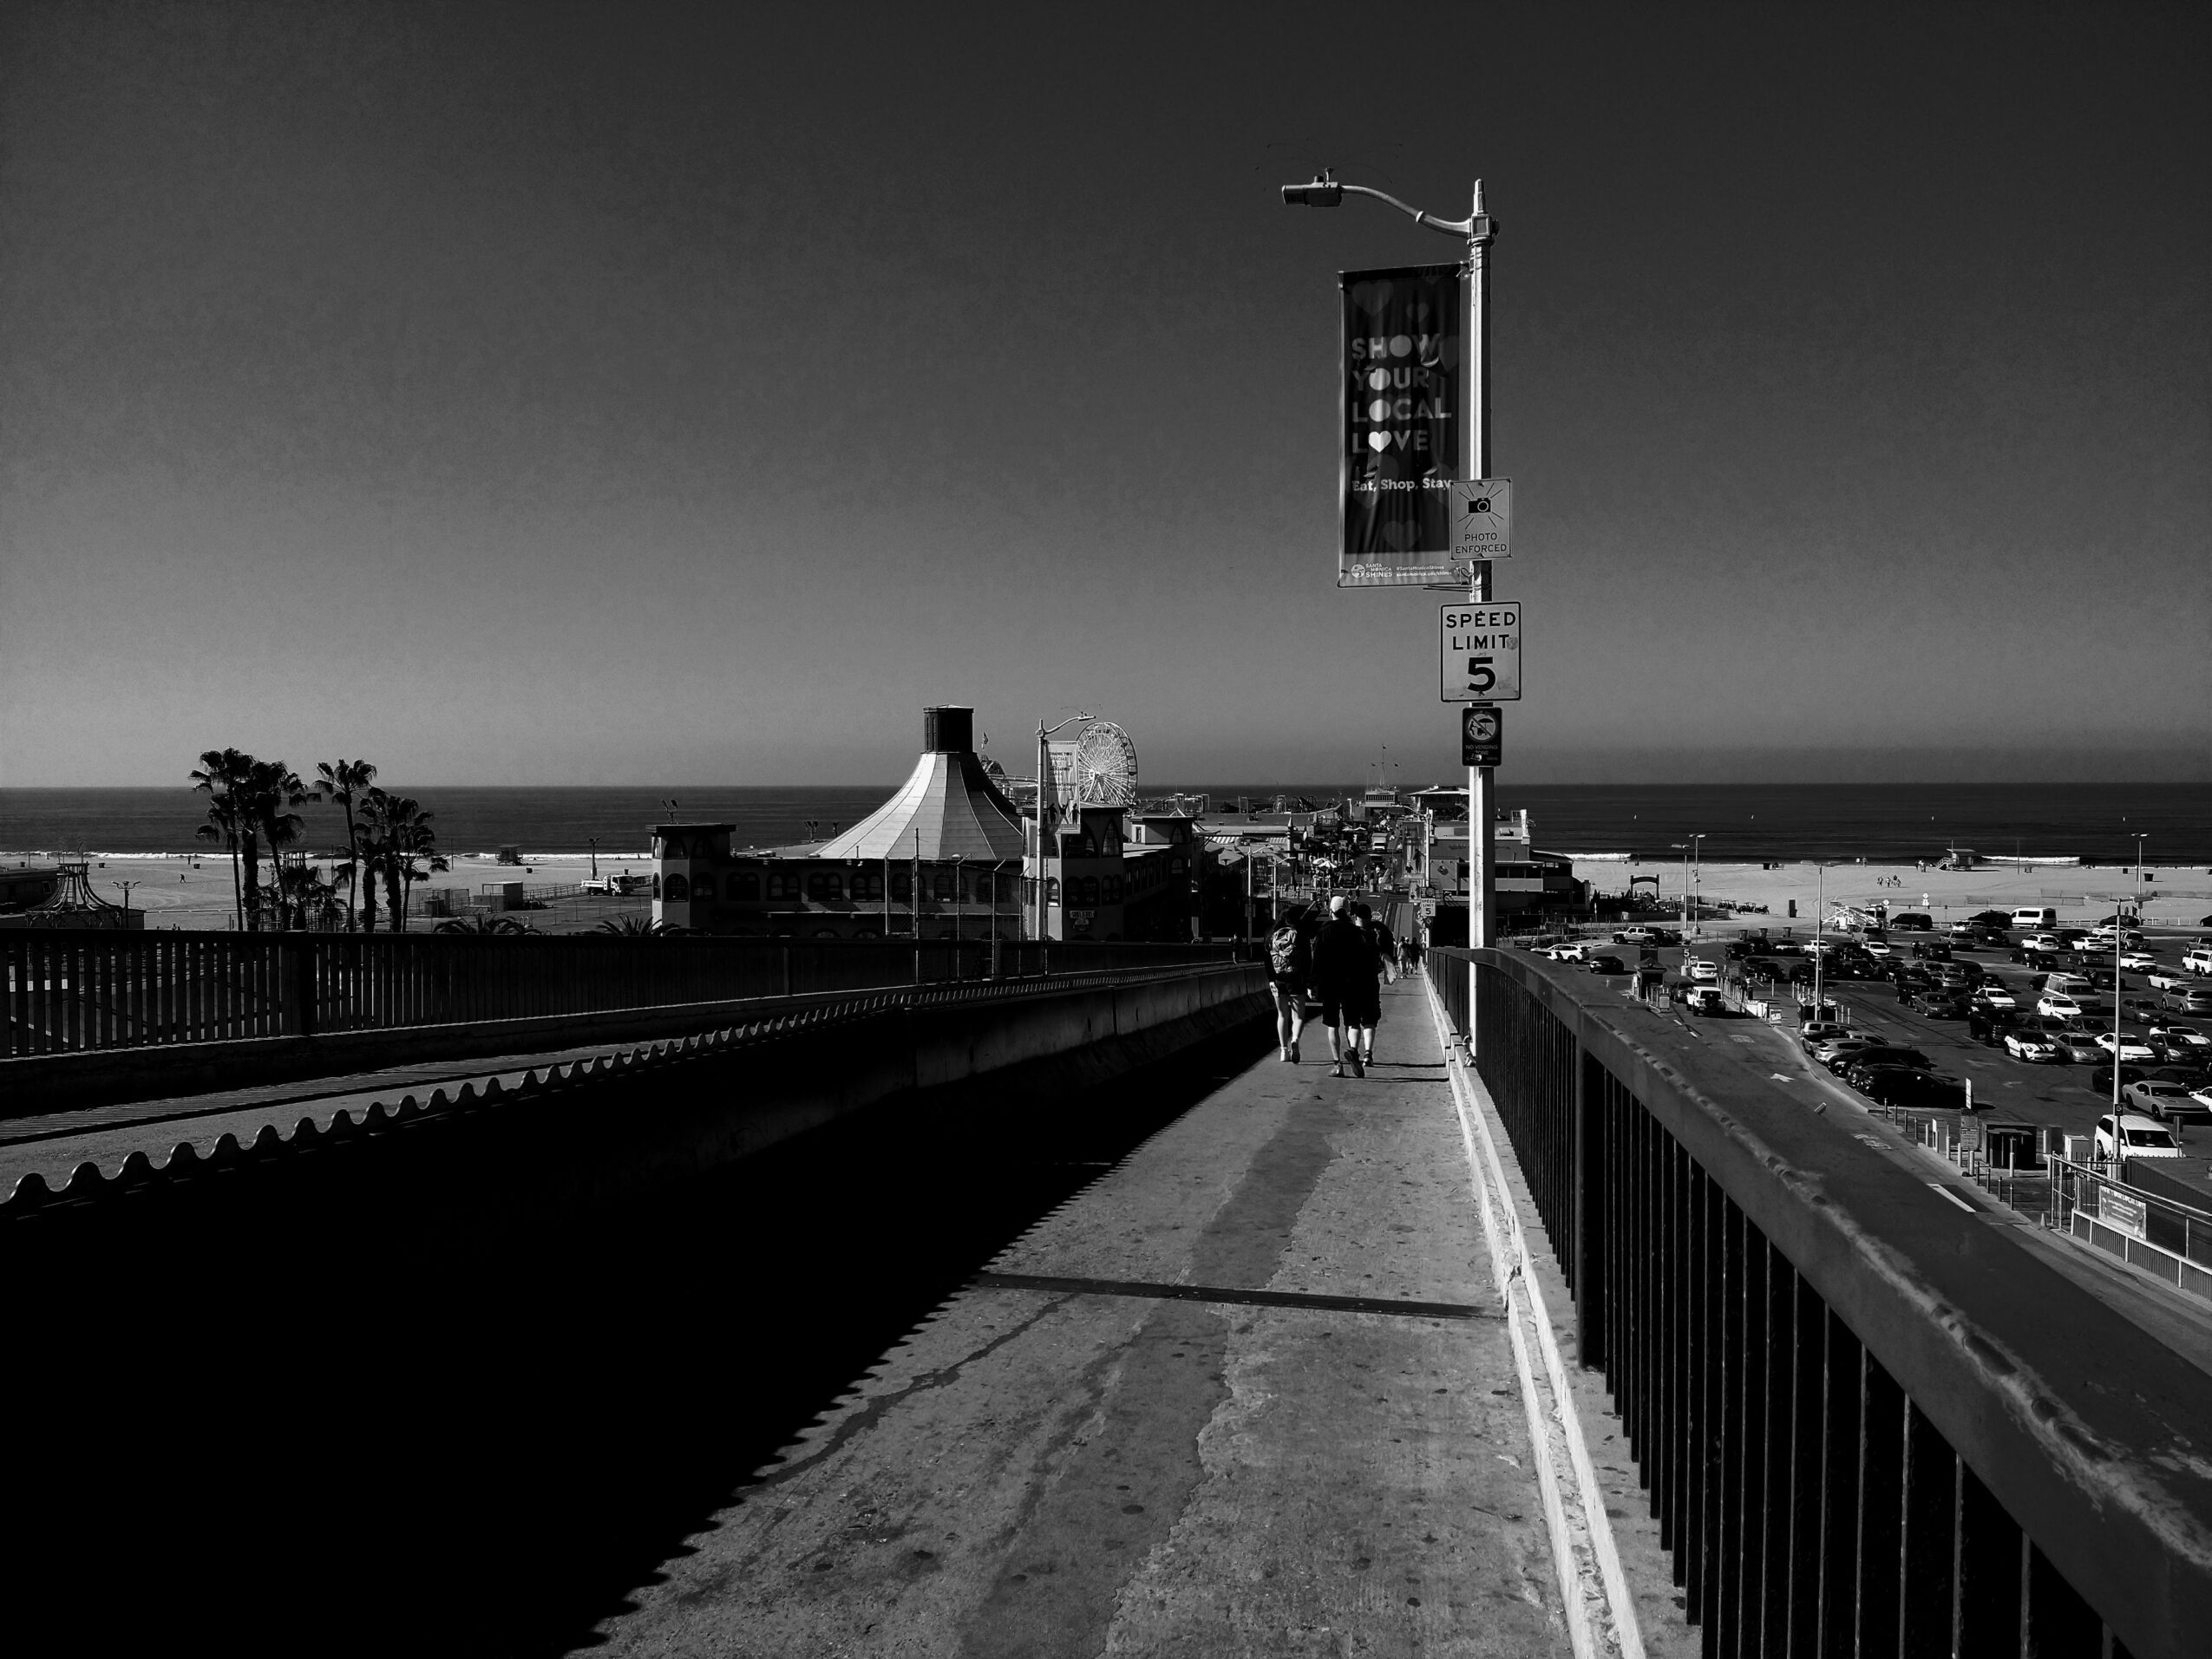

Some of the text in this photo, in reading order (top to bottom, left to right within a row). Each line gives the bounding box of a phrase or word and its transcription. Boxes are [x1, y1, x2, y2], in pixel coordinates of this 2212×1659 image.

[1351, 334, 1440, 360] SHOW
[1351, 366, 1430, 391] YOUR
[1351, 397, 1452, 422] LOCAL
[1352, 480, 1377, 493] Eat,
[1464, 532, 1497, 541] PHOTO
[1456, 544, 1507, 553] ENFORCED
[1446, 611, 1515, 629] SPEED
[1453, 634, 1509, 650] LIMIT
[1468, 656, 1496, 692] 5
[1684, 949, 1690, 957] 5
